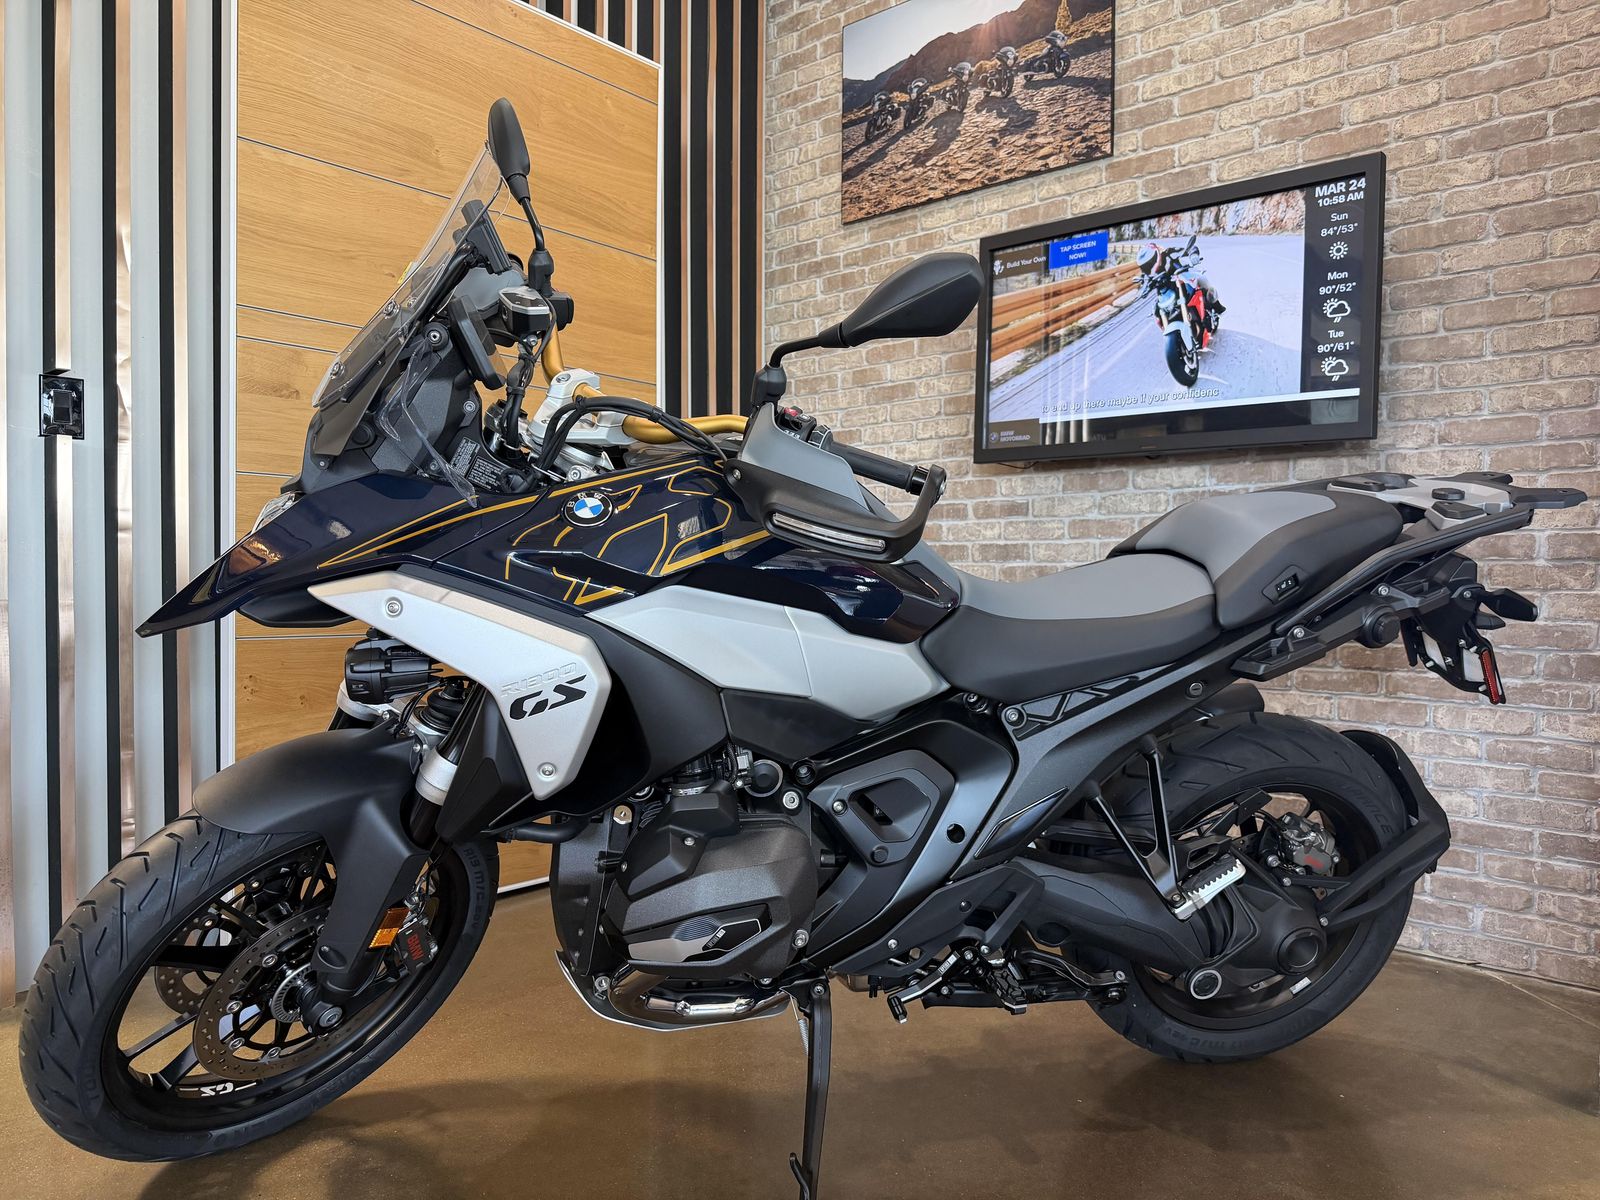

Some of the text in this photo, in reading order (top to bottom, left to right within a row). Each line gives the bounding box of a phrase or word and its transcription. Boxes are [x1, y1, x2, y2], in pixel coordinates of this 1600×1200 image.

[1315, 177, 1366, 198] MAR 24
[1317, 191, 1364, 207] 10:58 AM
[1330, 213, 1348, 222] Sun
[1320, 222, 1358, 237] 84°/53°
[1060, 240, 1097, 253] TAP SCREEN
[1006, 256, 1047, 269] Build Your Own
[1069, 252, 1087, 260] NOW!
[1327, 271, 1348, 281] Mon
[1319, 282, 1356, 295] 90°/52°
[1328, 329, 1344, 338] Tue
[1317, 341, 1354, 353] 90°/61°
[1107, 395, 1138, 408] maybe
[1148, 393, 1170, 405] your
[567, 492, 604, 508] BMW
[509, 673, 588, 721] GS
